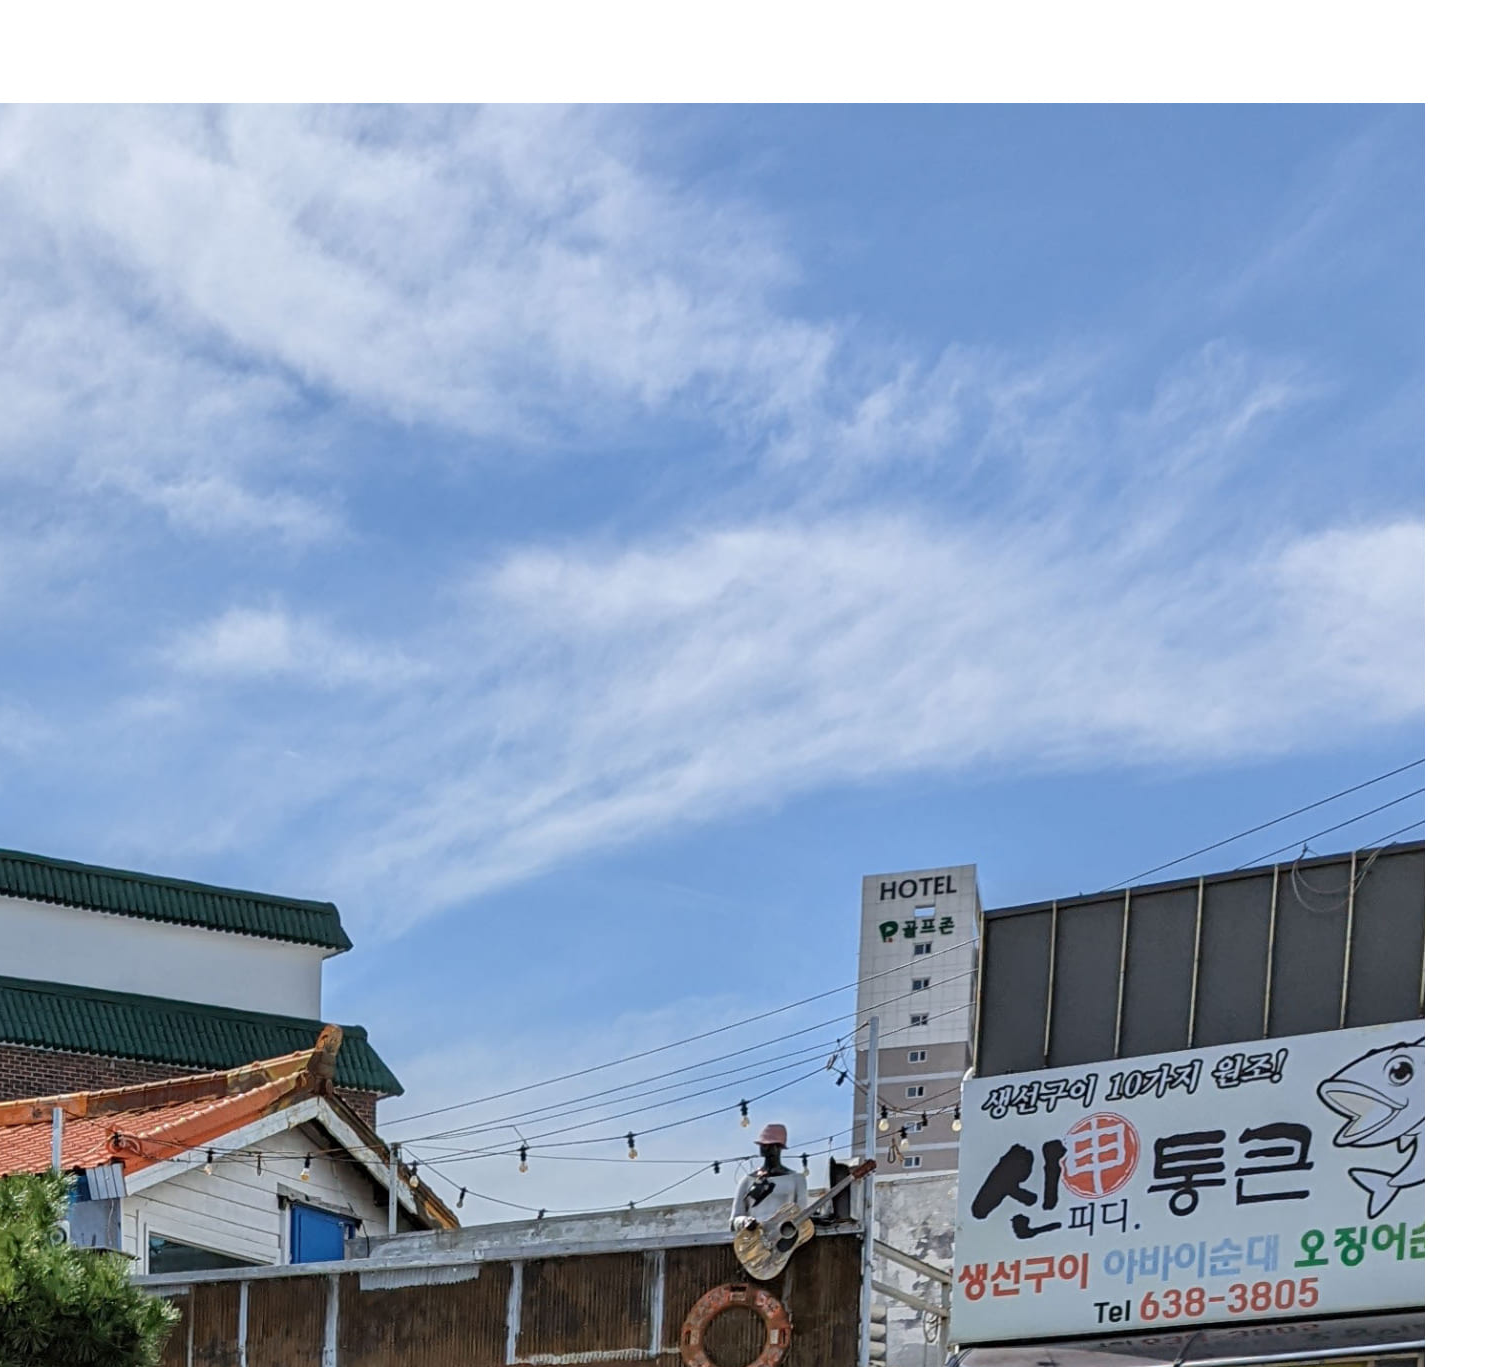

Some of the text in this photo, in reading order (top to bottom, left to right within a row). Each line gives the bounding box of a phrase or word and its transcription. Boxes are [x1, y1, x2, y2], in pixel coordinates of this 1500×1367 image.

[880, 875, 958, 901] HOTEL
[902, 916, 956, 939] 골프존
[982, 1048, 1289, 1119] 생선구이 10가지 원조!
[971, 1140, 1067, 1239] 신
[1147, 1123, 1314, 1217] 통큰
[958, 1253, 1089, 1301] 생선구이
[1103, 1235, 1280, 1285] 아바이순대
[1094, 1277, 1319, 1324] Tel 638-3805
